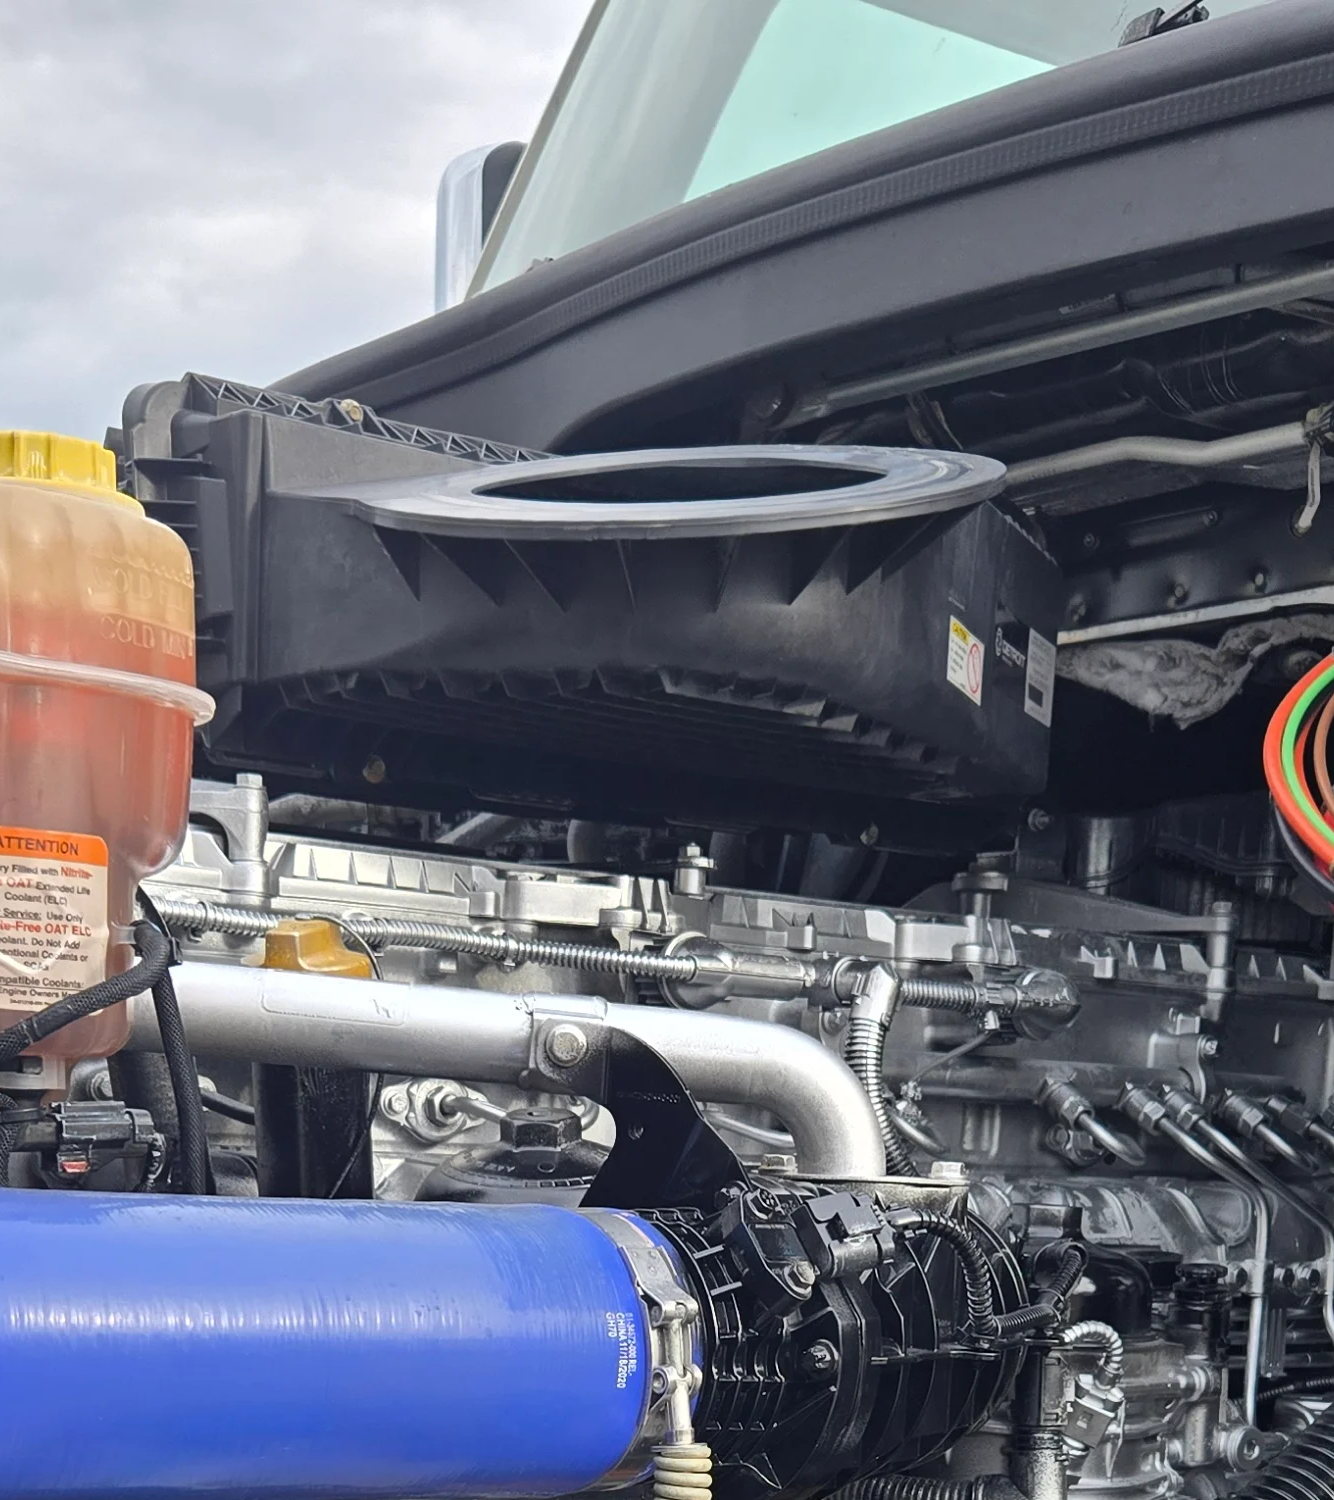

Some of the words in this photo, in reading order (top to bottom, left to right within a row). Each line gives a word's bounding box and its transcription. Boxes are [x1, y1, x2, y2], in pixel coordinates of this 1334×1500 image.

[12, 864, 38, 875] Filled
[41, 867, 59, 877] with
[6, 876, 33, 889] OAT
[77, 886, 91, 896] Life
[4, 891, 42, 904] Coolant
[44, 895, 68, 907] (ELC)
[3, 907, 42, 920] Service:
[46, 911, 64, 921] Use
[65, 913, 84, 924] Only
[44, 923, 69, 935] OAT
[71, 926, 92, 937] ELC
[31, 937, 44, 946] Do
[46, 939, 62, 949] Not
[64, 941, 81, 950] Add
[42, 977, 85, 989] Coolants:
[29, 988, 60, 999] Owners
[605, 1311, 618, 1338] GH70
[616, 1312, 628, 1341] CHINA
